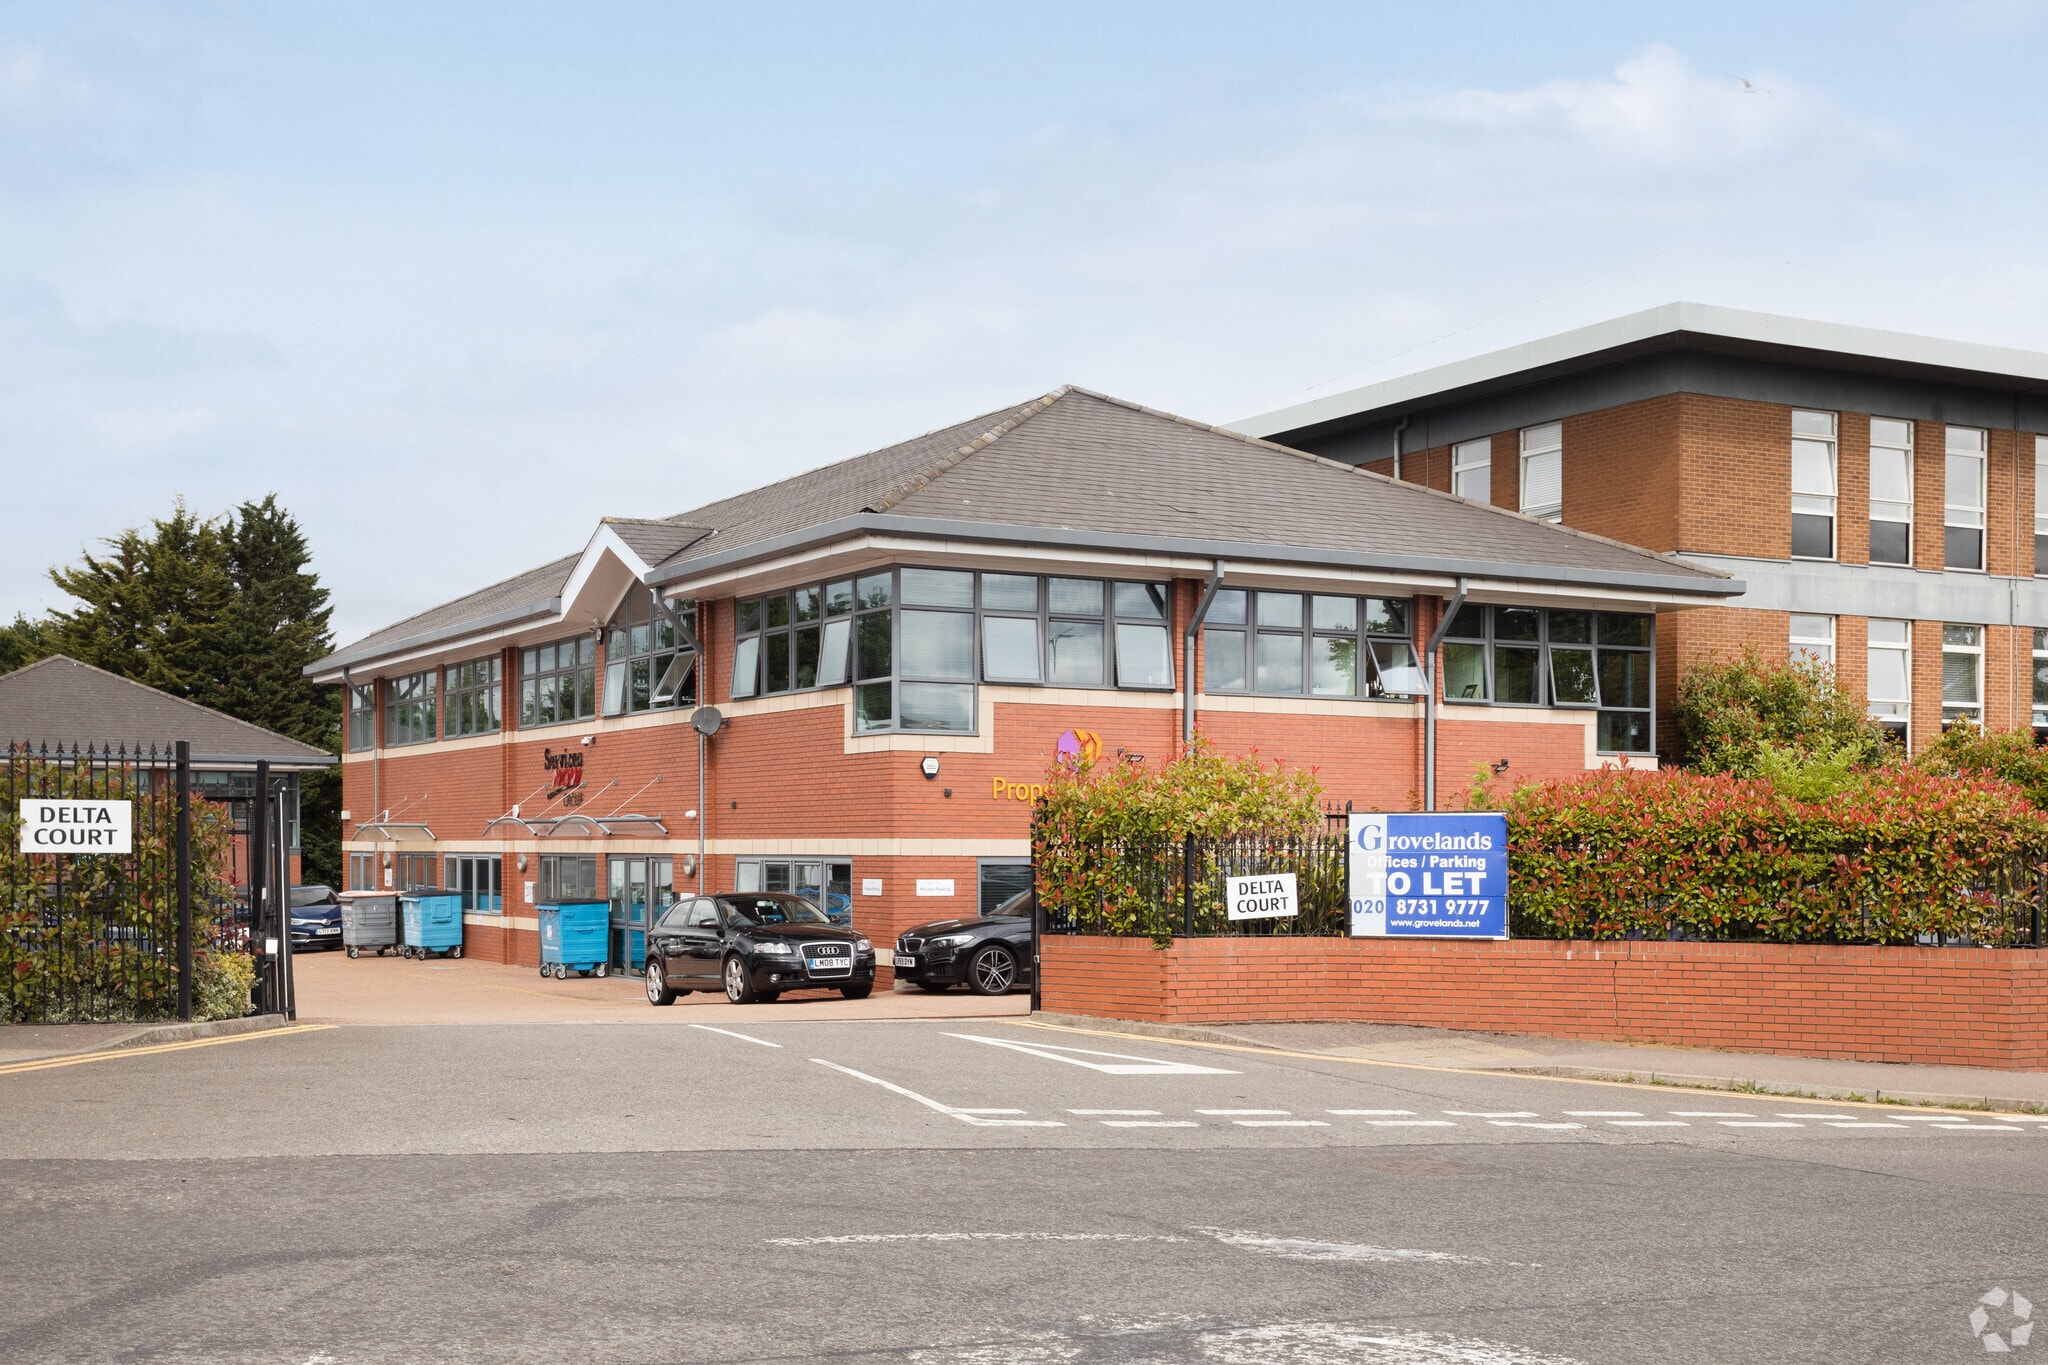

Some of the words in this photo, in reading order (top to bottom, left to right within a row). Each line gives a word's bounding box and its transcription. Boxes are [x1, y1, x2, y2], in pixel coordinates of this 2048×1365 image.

[993, 776, 1050, 807] Prop
[40, 806, 112, 824] DELTA
[34, 828, 118, 845] COURT
[1357, 824, 1493, 851] Grovelands
[1367, 855, 1418, 868] Offices
[1430, 855, 1486, 871] Parking
[1239, 880, 1284, 895] DELTA
[1366, 872, 1411, 895] TO
[1423, 872, 1487, 895] LET
[1237, 896, 1289, 913] COURT
[1353, 899, 1385, 914] 020
[1396, 899, 1437, 915] 8731
[1445, 899, 1490, 915] 9777
[1390, 919, 1480, 928] www.grovelands.net
[814, 959, 834, 967] LM08
[836, 958, 848, 966] TYC
